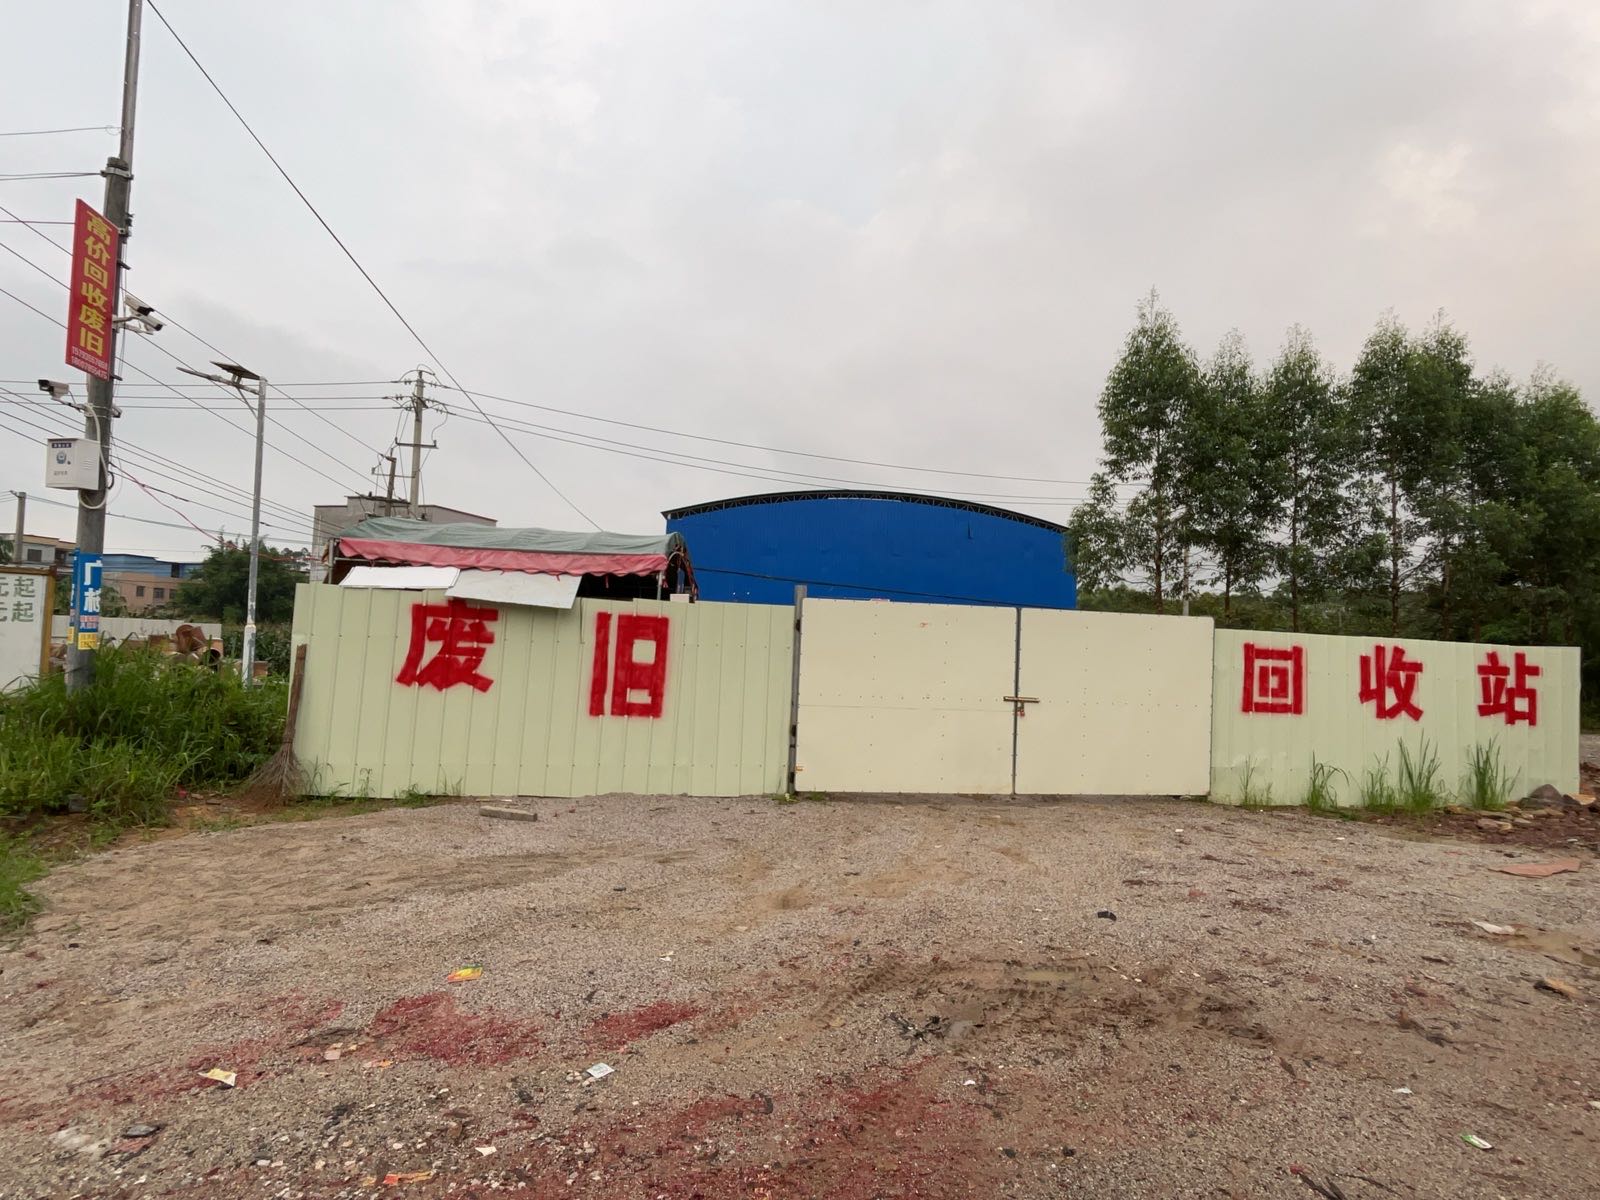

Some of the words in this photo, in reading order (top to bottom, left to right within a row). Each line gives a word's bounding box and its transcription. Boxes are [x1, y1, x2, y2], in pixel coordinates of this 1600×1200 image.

[79, 210, 112, 357] 高价回收废旧
